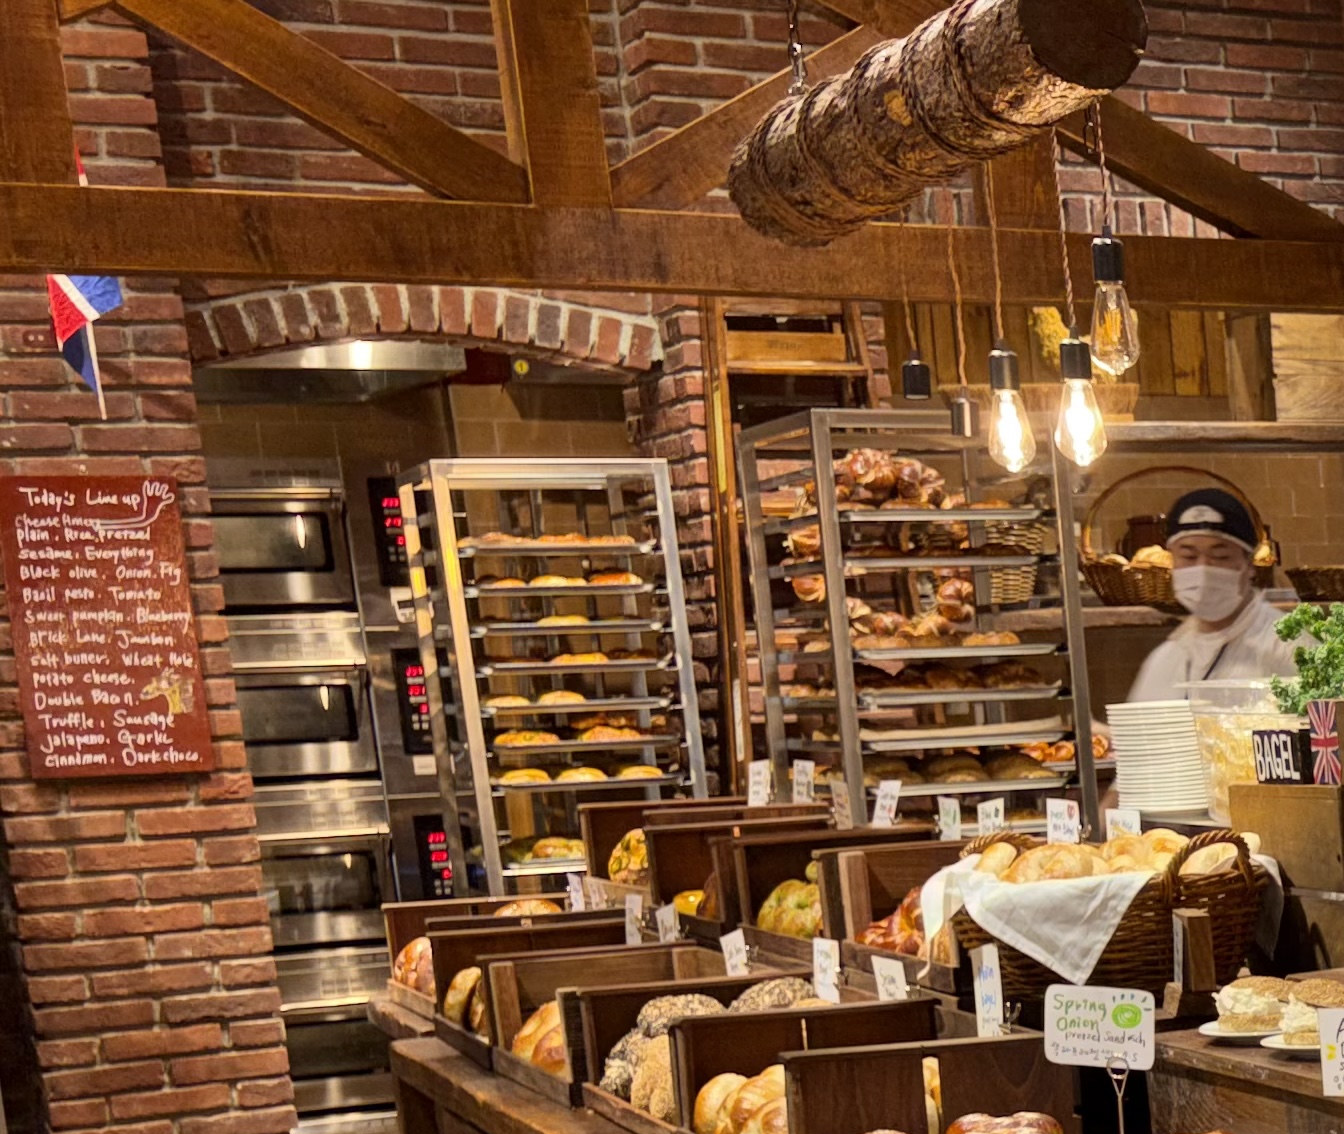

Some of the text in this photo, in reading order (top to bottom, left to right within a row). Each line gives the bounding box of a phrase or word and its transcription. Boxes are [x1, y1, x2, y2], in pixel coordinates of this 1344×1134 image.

[122, 493, 141, 511] up
[85, 545, 154, 566] Everything
[20, 564, 60, 580] Black
[160, 561, 181, 586] Fig
[34, 690, 84, 710] Double
[1253, 733, 1301, 782] BAGEL
[1053, 993, 1107, 1022] Spring
[1056, 1016, 1100, 1034] Onion
